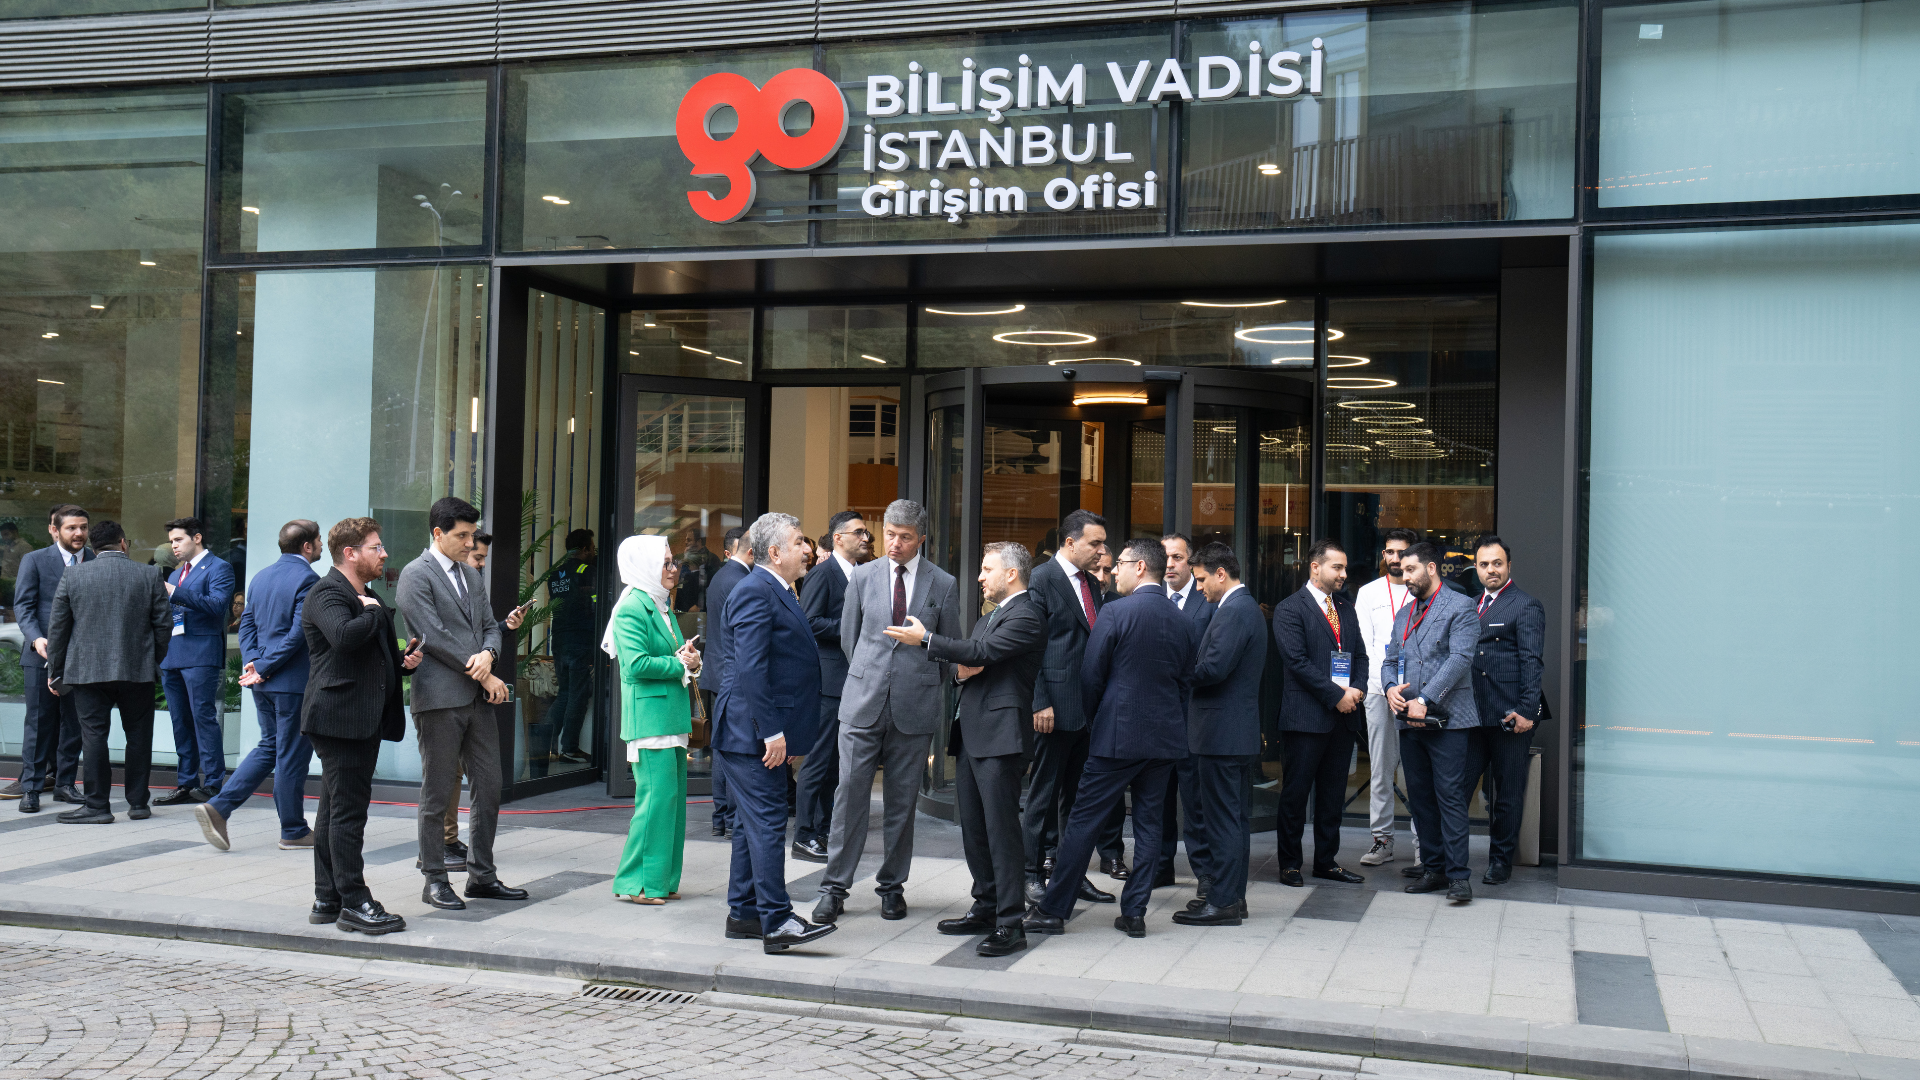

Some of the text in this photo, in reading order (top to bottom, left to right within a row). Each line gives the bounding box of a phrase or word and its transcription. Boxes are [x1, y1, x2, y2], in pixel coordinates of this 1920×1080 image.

[866, 37, 1323, 124] BİLİŞİM VADİSİ
[675, 67, 849, 225] go
[863, 122, 1134, 173] İSTANBUL
[861, 170, 1158, 225] Girişim Ofisi
[1441, 563, 1455, 577] go
